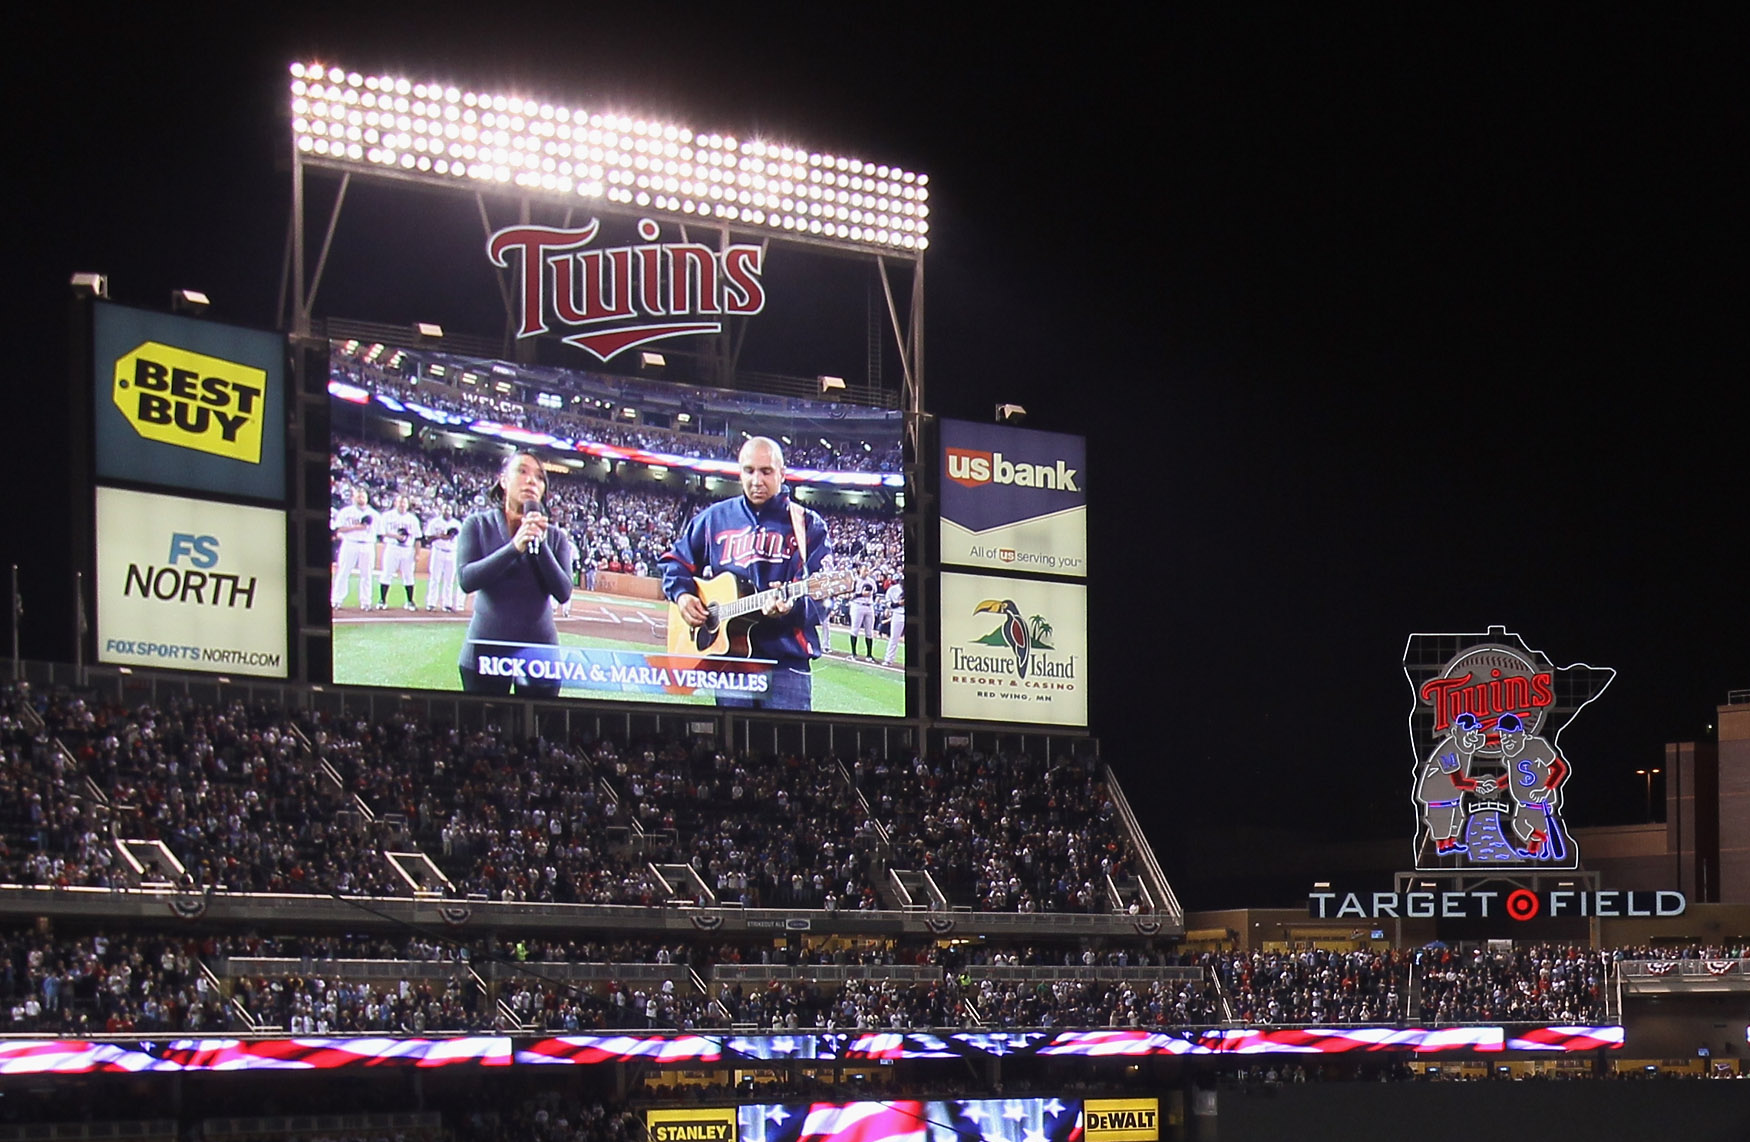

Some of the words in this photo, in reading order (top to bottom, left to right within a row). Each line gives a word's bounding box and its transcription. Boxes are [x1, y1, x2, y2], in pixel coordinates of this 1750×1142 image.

[488, 217, 766, 339] Twins
[135, 358, 262, 414] BEST
[138, 392, 249, 443] BUY
[168, 532, 220, 569] FS
[970, 546, 985, 558] All
[986, 548, 998, 560] of
[1016, 552, 1056, 568] serving
[1058, 556, 1078, 569] you
[123, 563, 257, 610] NORTH
[478, 656, 526, 678] RICK
[528, 659, 587, 682] OLIVA
[590, 664, 607, 683] &
[611, 666, 672, 687] MARIA
[671, 670, 769, 693] VERSALLES
[950, 646, 1015, 675] Treasure
[1030, 653, 1075, 679] Island
[952, 676, 1004, 686] RESORT
[1025, 681, 1075, 691] CASINO
[1000, 693, 1031, 701] WING,
[1421, 668, 1553, 731] Twins
[1309, 891, 1498, 919] TARGET
[1550, 890, 1686, 917] FIELD
[656, 1125, 727, 1141] STANLEY
